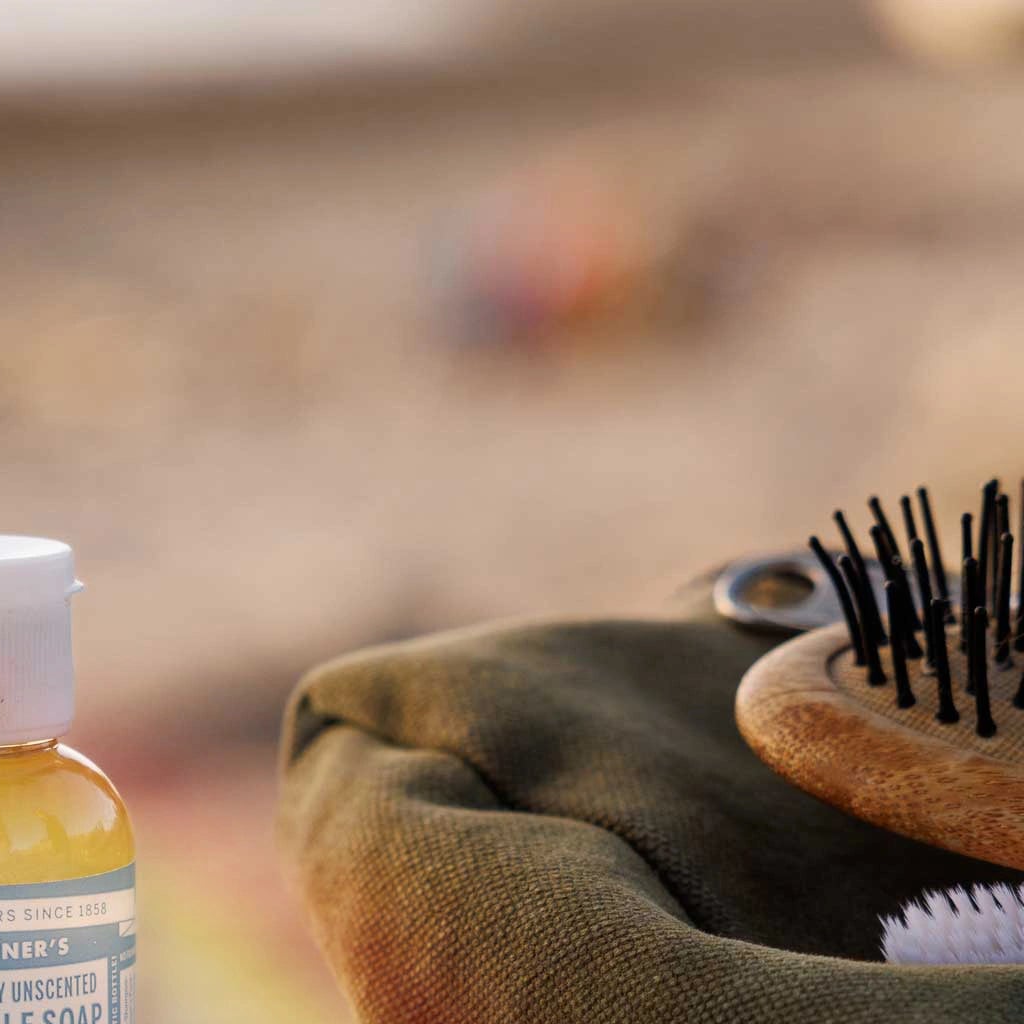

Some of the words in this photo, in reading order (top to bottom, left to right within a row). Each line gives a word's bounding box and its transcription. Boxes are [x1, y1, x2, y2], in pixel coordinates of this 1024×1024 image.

[23, 905, 73, 921] SINCE
[79, 902, 108, 917] 1858
[12, 972, 97, 1003] UNSCENTED
